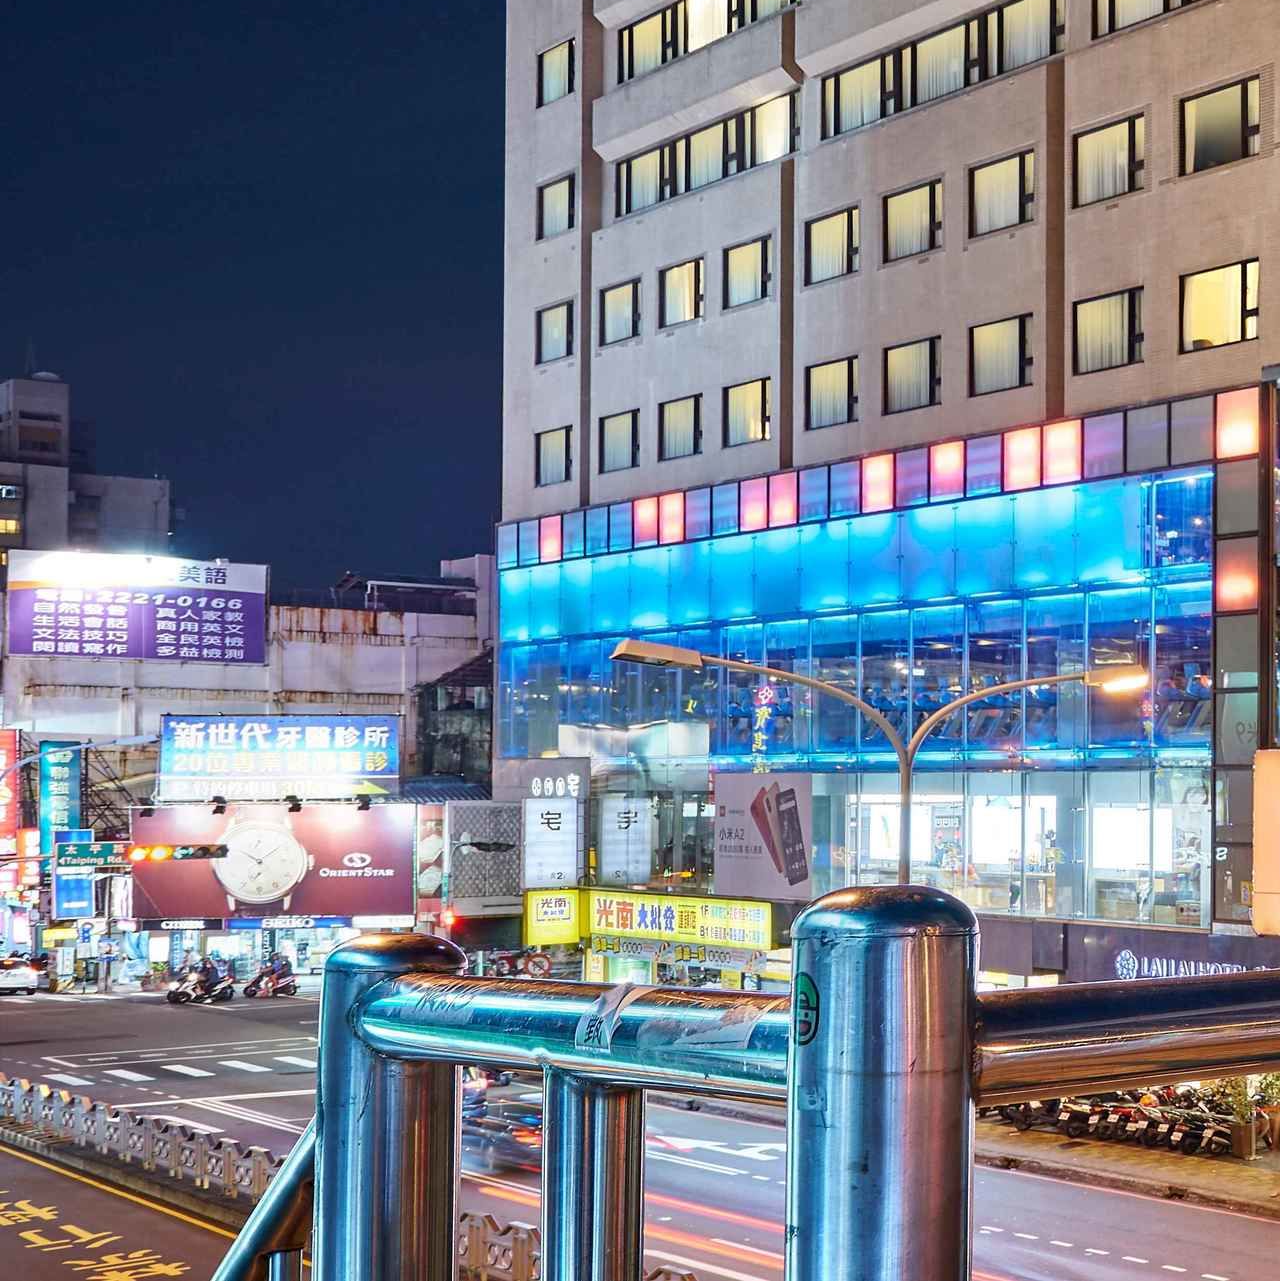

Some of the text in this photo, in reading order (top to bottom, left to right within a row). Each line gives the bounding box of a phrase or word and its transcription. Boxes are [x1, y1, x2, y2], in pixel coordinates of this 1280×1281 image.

[178, 565, 228, 586] 美語
[32, 615, 128, 629] 生活會話
[156, 607, 244, 623] 真人家教
[156, 620, 244, 635] 商用英文
[32, 628, 128, 642] 文法技巧
[156, 633, 244, 647] 全民英檢
[156, 645, 244, 660] 多益檢測
[65, 844, 125, 855] 太平路
[65, 856, 104, 866] Taiping
